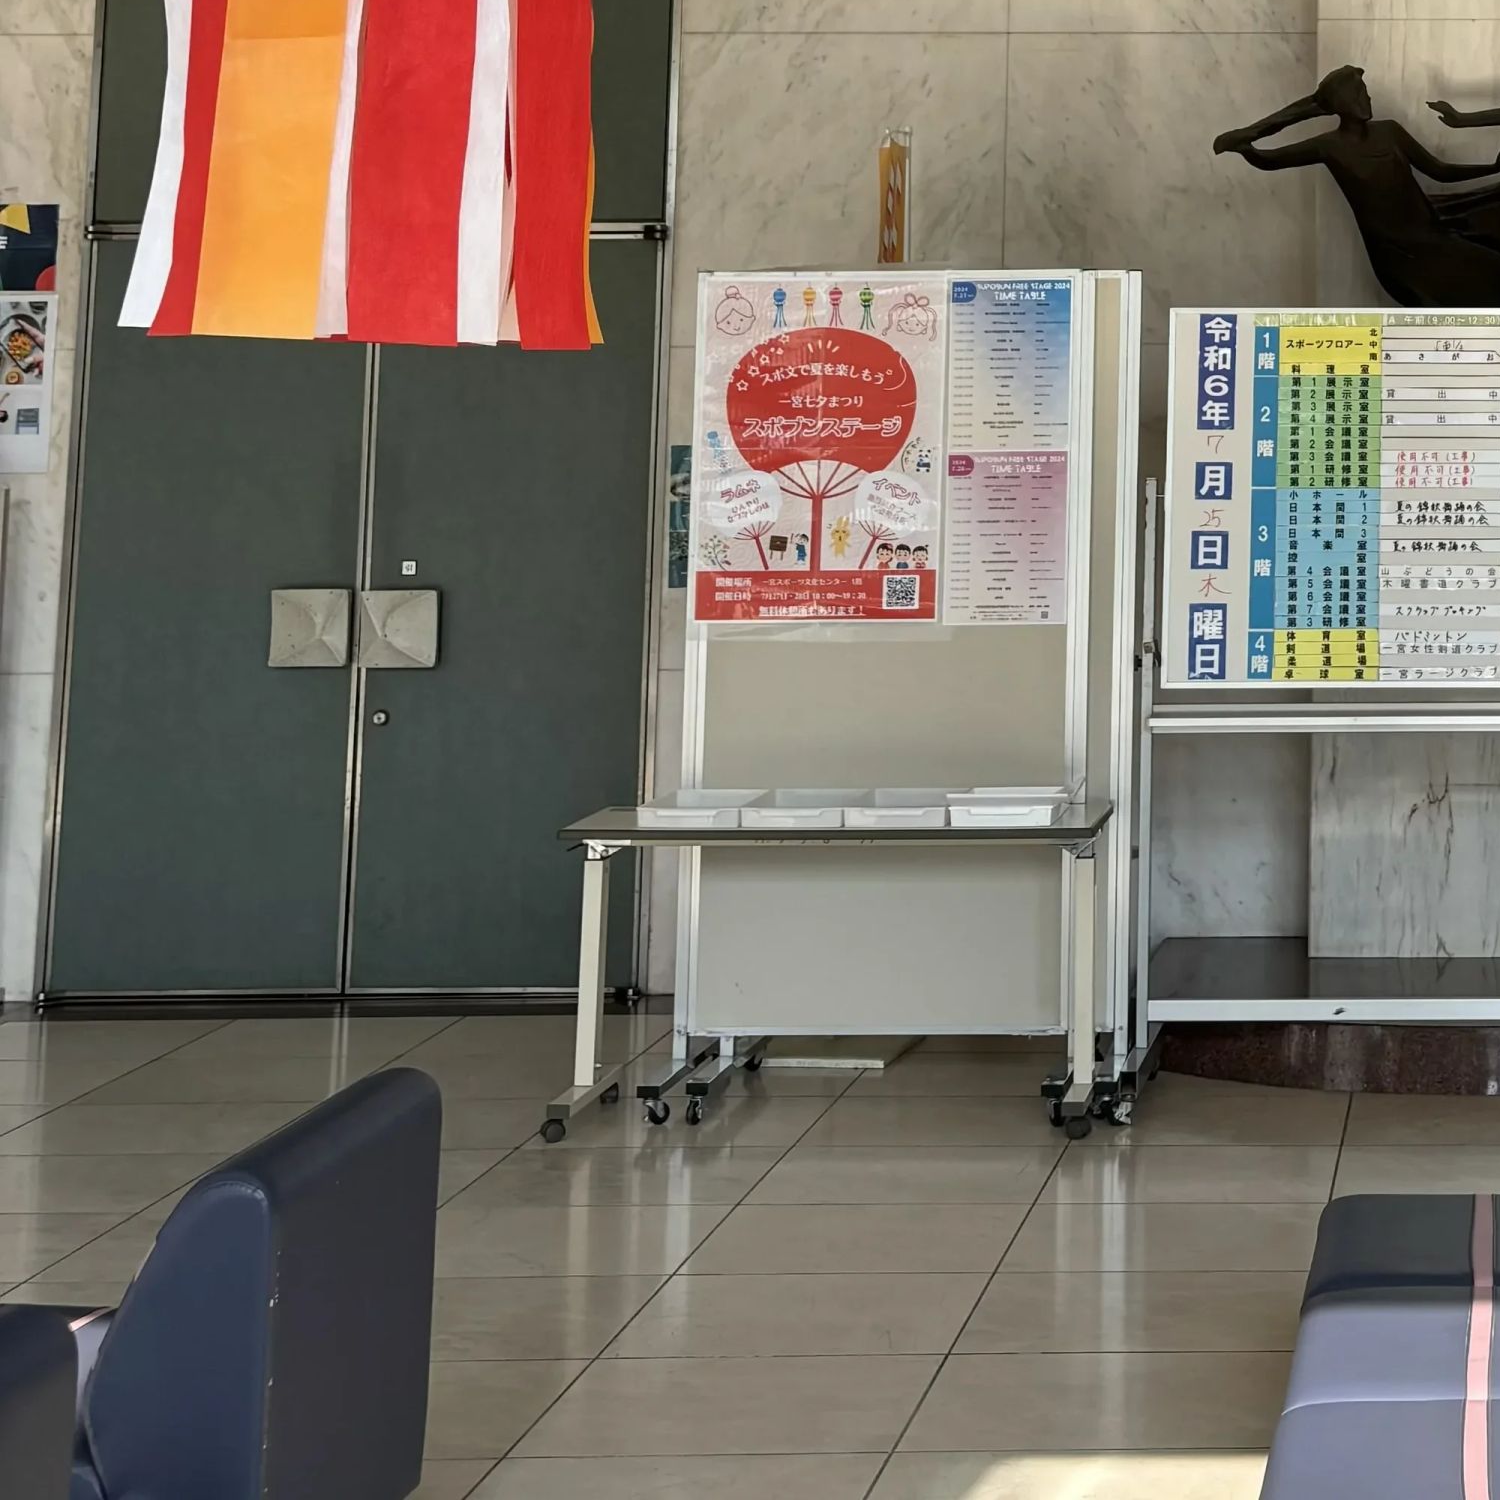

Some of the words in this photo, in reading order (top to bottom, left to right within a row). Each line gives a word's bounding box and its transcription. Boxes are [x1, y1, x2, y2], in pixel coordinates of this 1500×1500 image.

[994, 291, 1017, 300] TIME
[1019, 291, 1047, 300] TABLE
[1369, 328, 1378, 337] 北
[1286, 339, 1364, 349] スポーツフロアー
[1369, 340, 1378, 349] 中
[1258, 332, 1275, 370] 1階
[1201, 316, 1234, 426] 令和6年
[1292, 365, 1370, 374] 料理室
[1292, 377, 1370, 388] 第1展示室
[1291, 389, 1369, 400] 第2展示室
[779, 395, 864, 409] 一宮七夕まつり
[1291, 401, 1369, 412] 第3展示室
[1290, 413, 1369, 424] 第4展示室
[743, 416, 902, 439] スポブンステージ
[1257, 406, 1274, 457] 2階
[1290, 426, 1369, 437] 第1会議室
[1207, 435, 1225, 454] 7
[1290, 439, 1368, 449] 第2会議室
[1290, 451, 1368, 462] 第3会議室
[1290, 464, 1368, 474] 第1研修室
[1200, 465, 1226, 496] 月
[1289, 476, 1368, 487] 第2研修室
[720, 478, 761, 504] ラムネ
[872, 478, 921, 506] イベント
[1289, 490, 1367, 499] 小ホール
[1289, 502, 1367, 512] 日本間1
[1200, 509, 1225, 528] 25
[1289, 515, 1367, 525] 日本間2
[1288, 528, 1366, 539] 日本間3
[1198, 535, 1223, 566] 日
[1289, 540, 1367, 551] 音楽室
[1254, 526, 1272, 577] 3階
[1287, 566, 1366, 577] 第4会議室
[1199, 573, 1232, 598] 木
[1288, 578, 1367, 589] 第5会議室
[1288, 591, 1367, 602] 第6会議室
[1287, 604, 1366, 615] 第7会議室
[1287, 617, 1366, 628] 第3研修室
[1287, 631, 1366, 641] 体育室
[1192, 609, 1224, 675] 曜日
[1251, 635, 1269, 673] 4階
[1284, 669, 1364, 679] 卓球室
